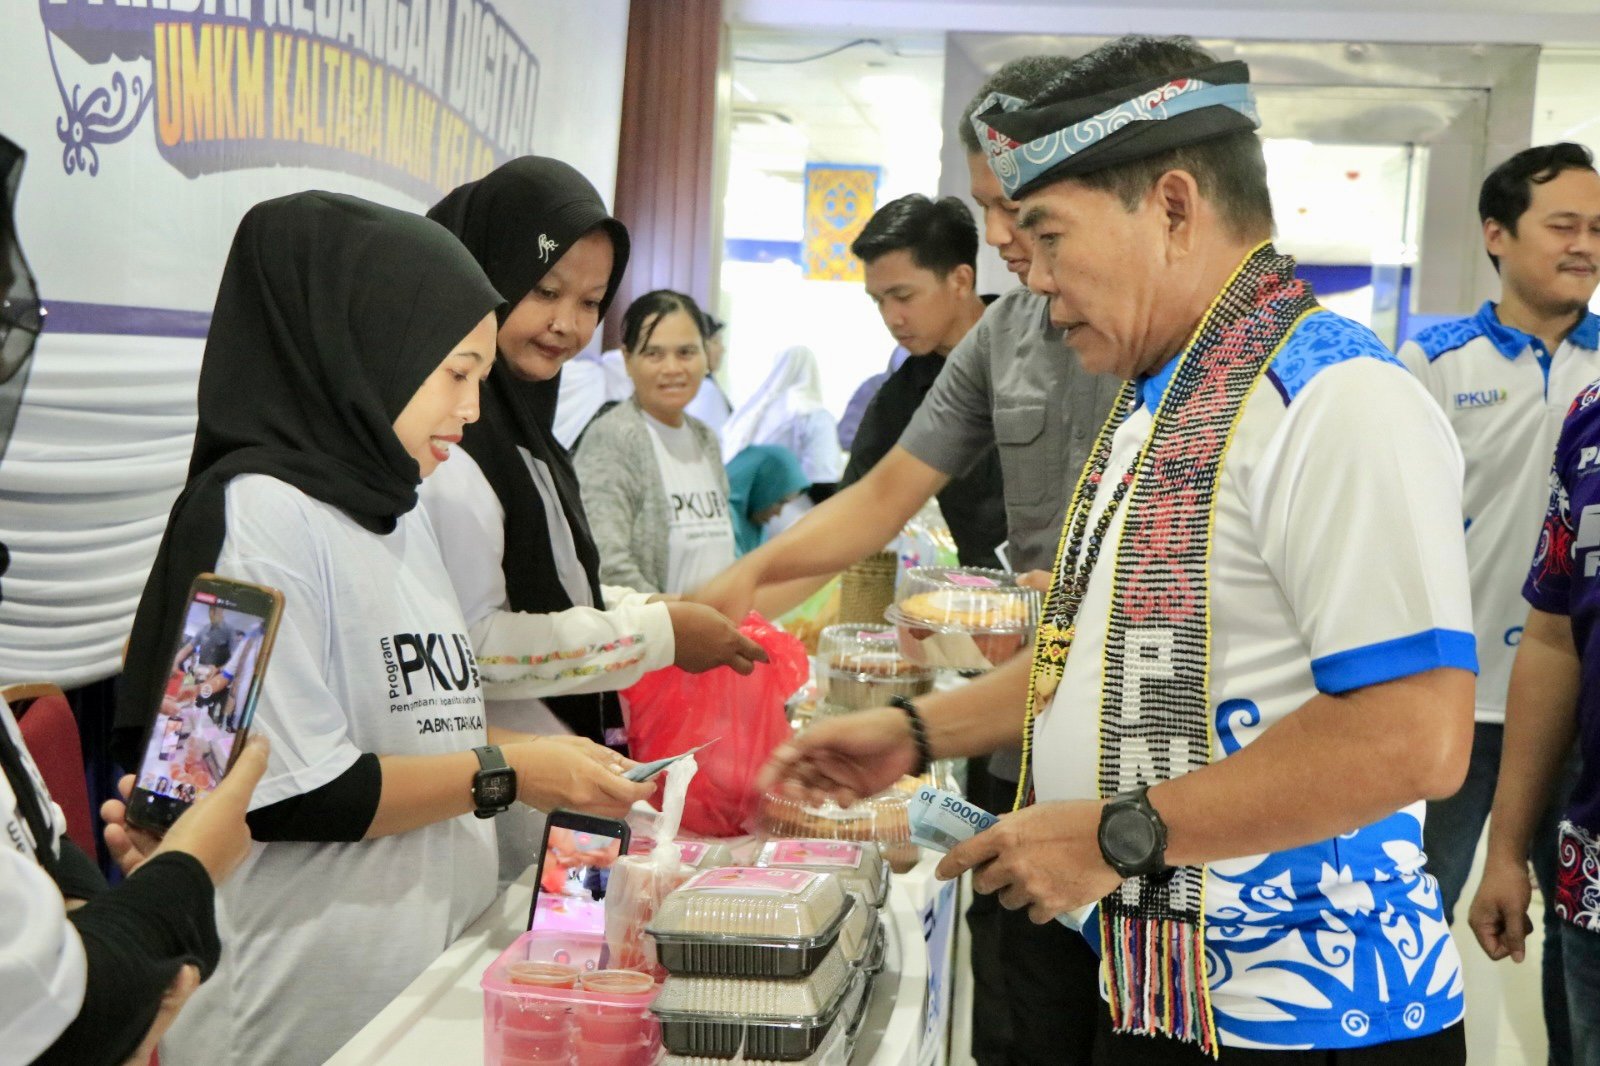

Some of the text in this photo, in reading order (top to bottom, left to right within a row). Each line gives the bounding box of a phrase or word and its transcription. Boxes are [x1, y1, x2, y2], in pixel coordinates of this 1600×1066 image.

[154, 22, 265, 146] UMKM
[272, 30, 384, 159] KALTARA
[380, 636, 400, 699] Program
[940, 796, 991, 830] 50000
